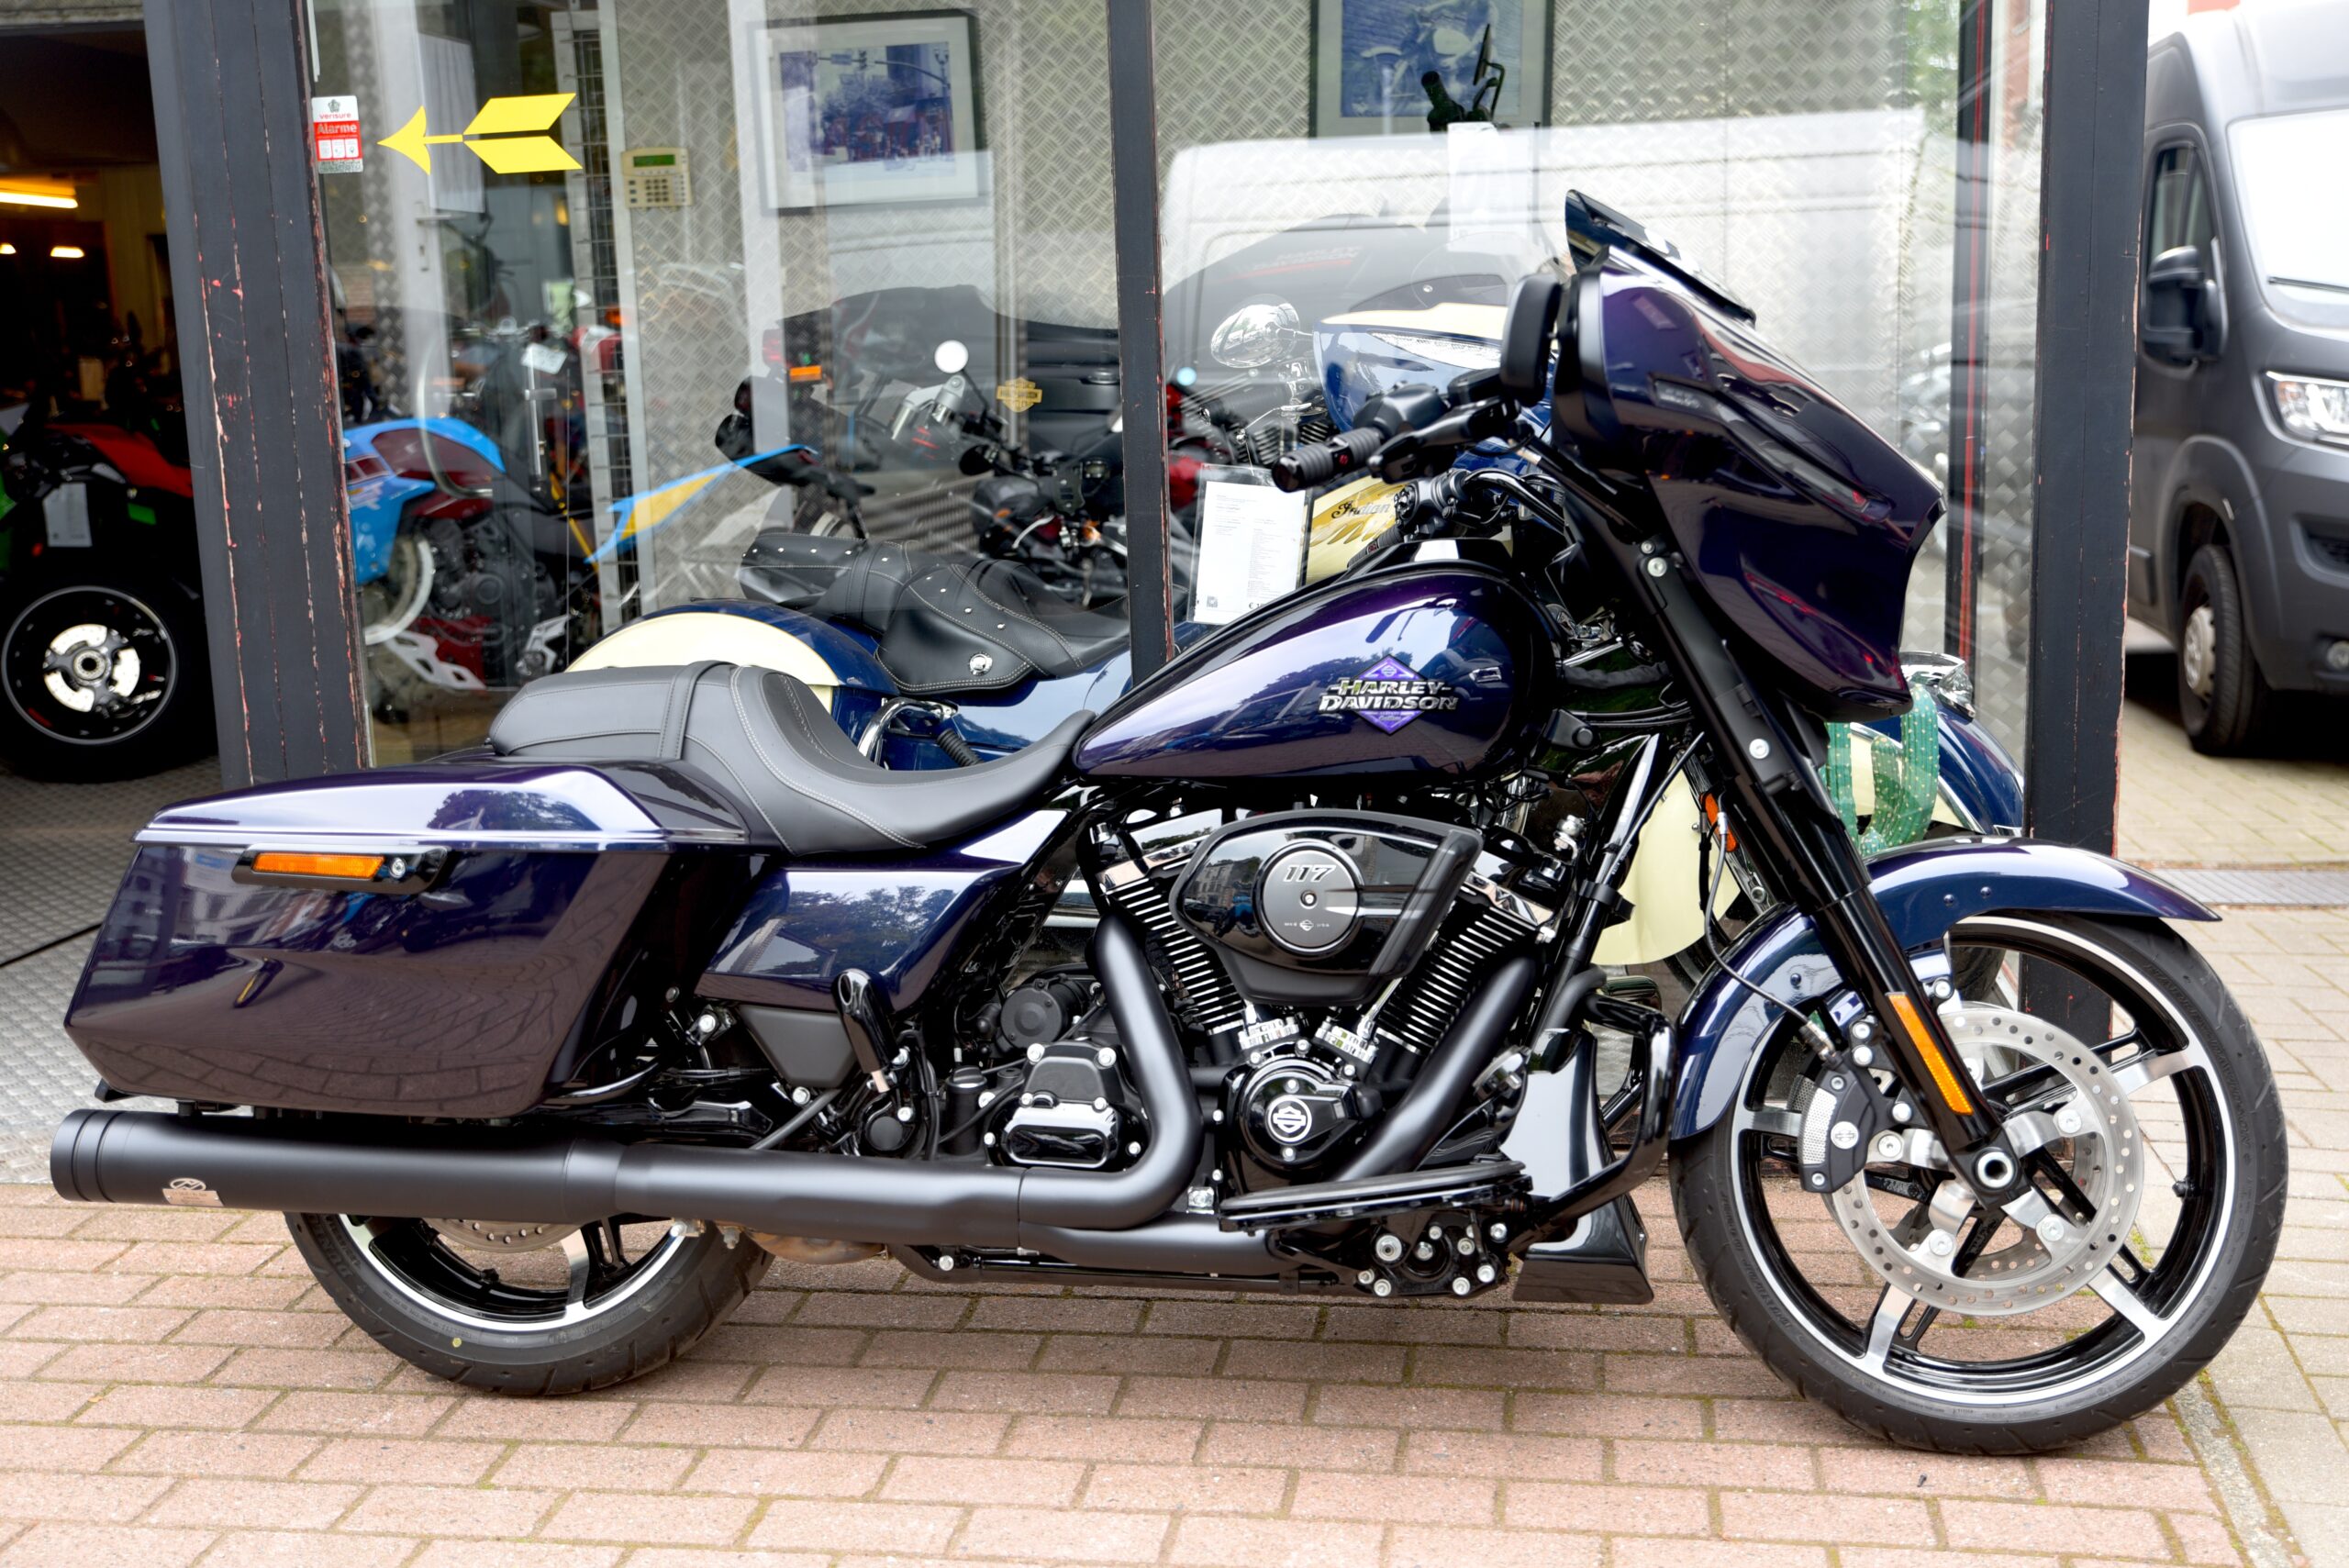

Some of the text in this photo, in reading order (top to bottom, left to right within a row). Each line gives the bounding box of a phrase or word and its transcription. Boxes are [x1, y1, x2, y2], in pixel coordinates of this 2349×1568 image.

[317, 123, 358, 135] Alarme
[1331, 500, 1391, 519] Indian
[1319, 696, 1459, 712] DAVIDSON
[1283, 863, 1337, 883] 117
